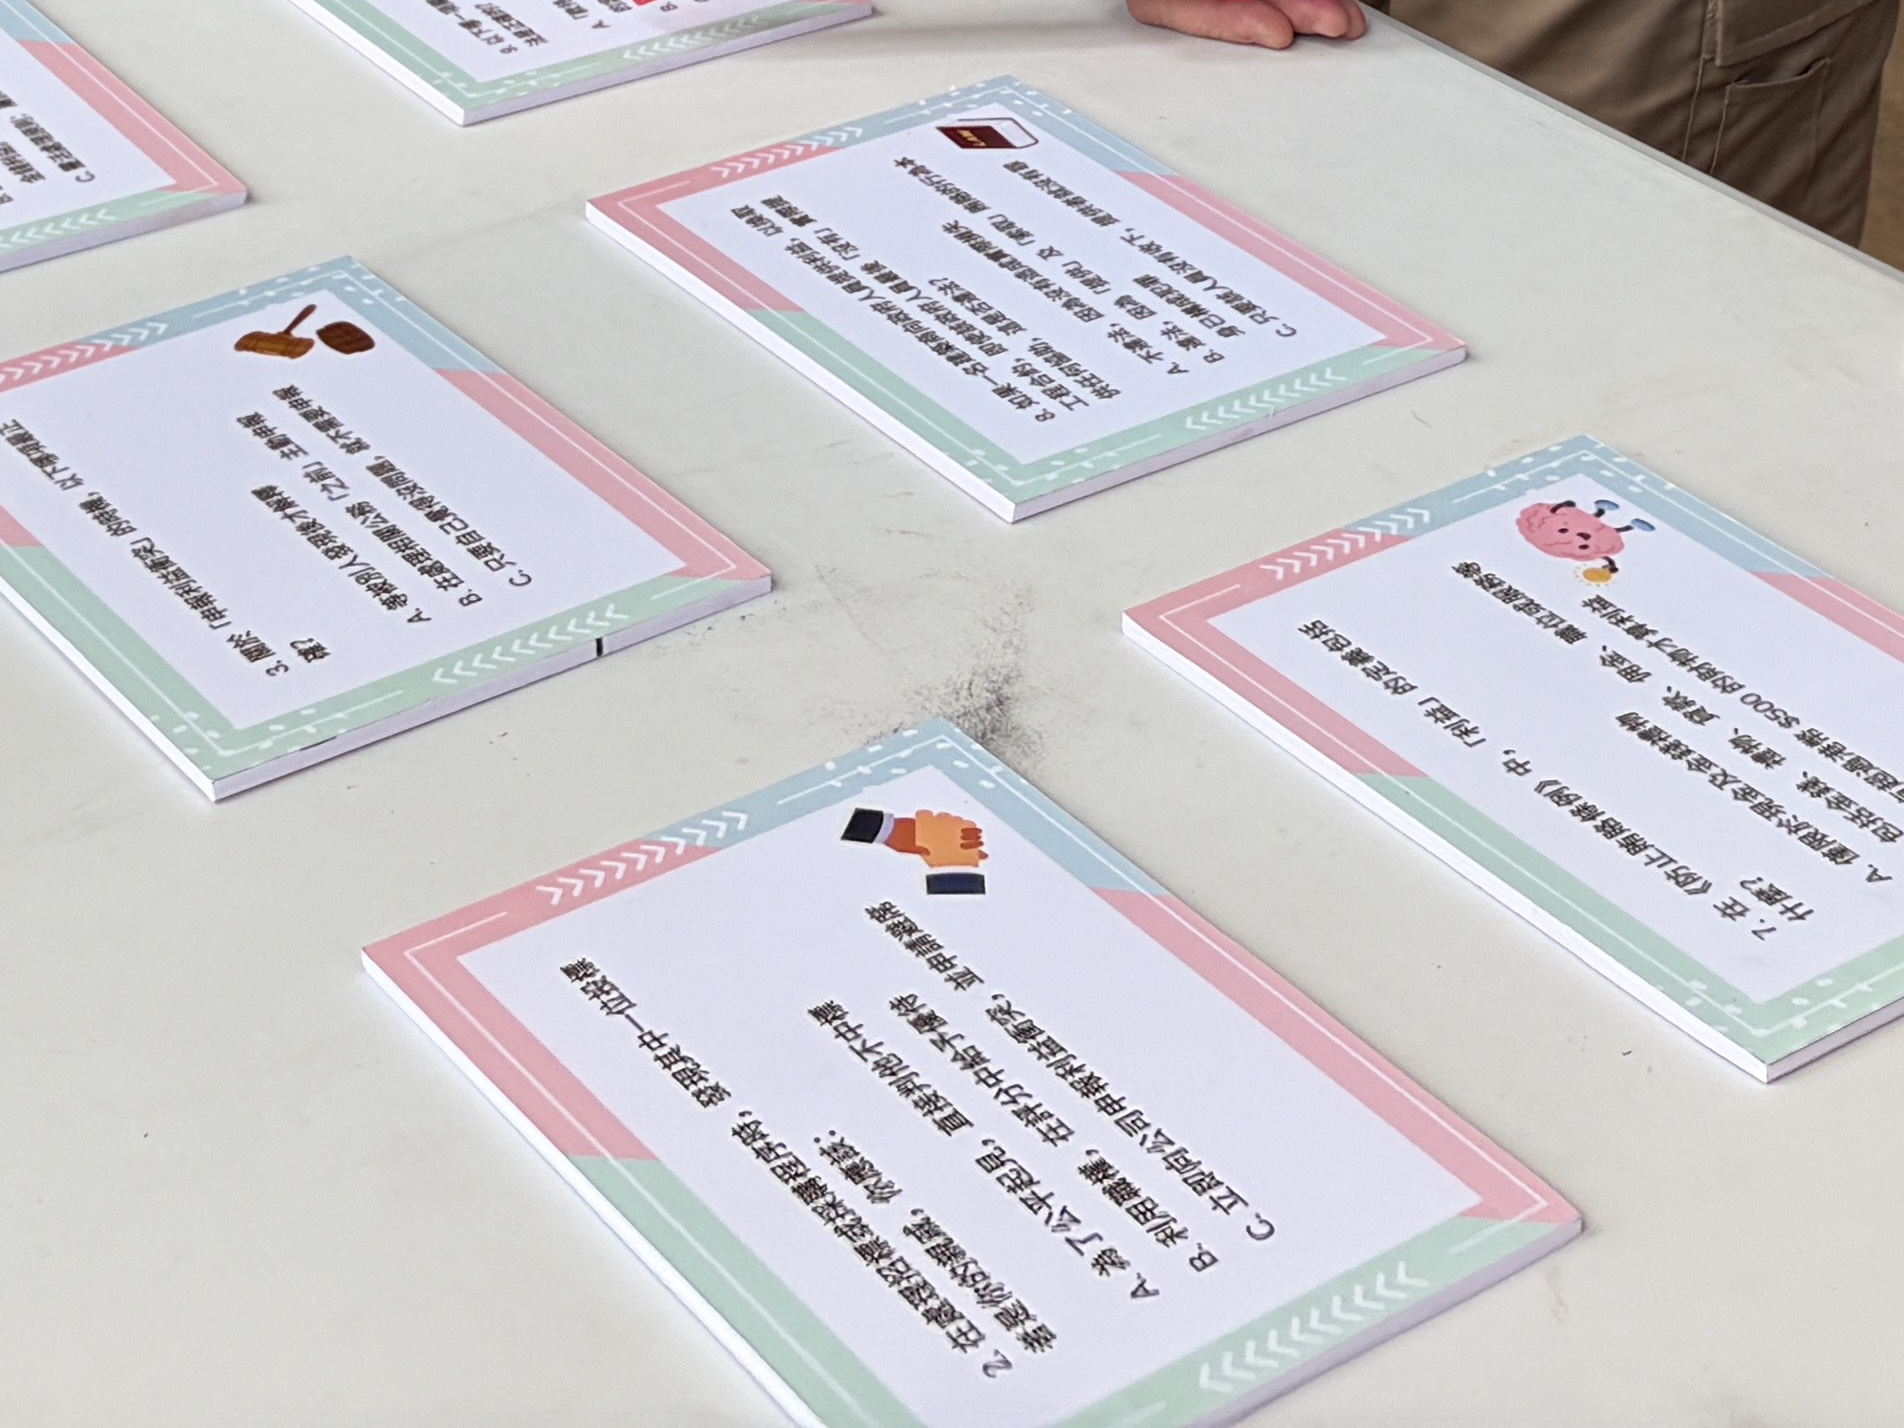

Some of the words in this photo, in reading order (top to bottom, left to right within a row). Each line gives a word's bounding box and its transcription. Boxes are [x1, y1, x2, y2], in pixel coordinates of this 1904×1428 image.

[1275, 323, 1298, 338] C.
[1166, 361, 1190, 375] A.
[1202, 348, 1226, 364] B.
[508, 569, 533, 588] C.
[458, 588, 484, 607] B.
[406, 607, 433, 624] A.
[1581, 594, 1746, 695] 的財物才算利益
[264, 659, 290, 677] 3.
[1739, 692, 1801, 730] $500
[1614, 711, 1861, 866] 僅限於現金及金錢禮物
[1865, 863, 1893, 884] A.
[1751, 918, 1777, 941] 7.
[888, 993, 1189, 1249] 利用職權，在評分中給予優待
[807, 999, 1131, 1277] 為了公平起見，直接判他不中標
[1245, 1212, 1276, 1242] C.
[1188, 1242, 1220, 1273] B.
[1129, 1272, 1160, 1300] A.
[981, 1348, 1013, 1379] 2.
